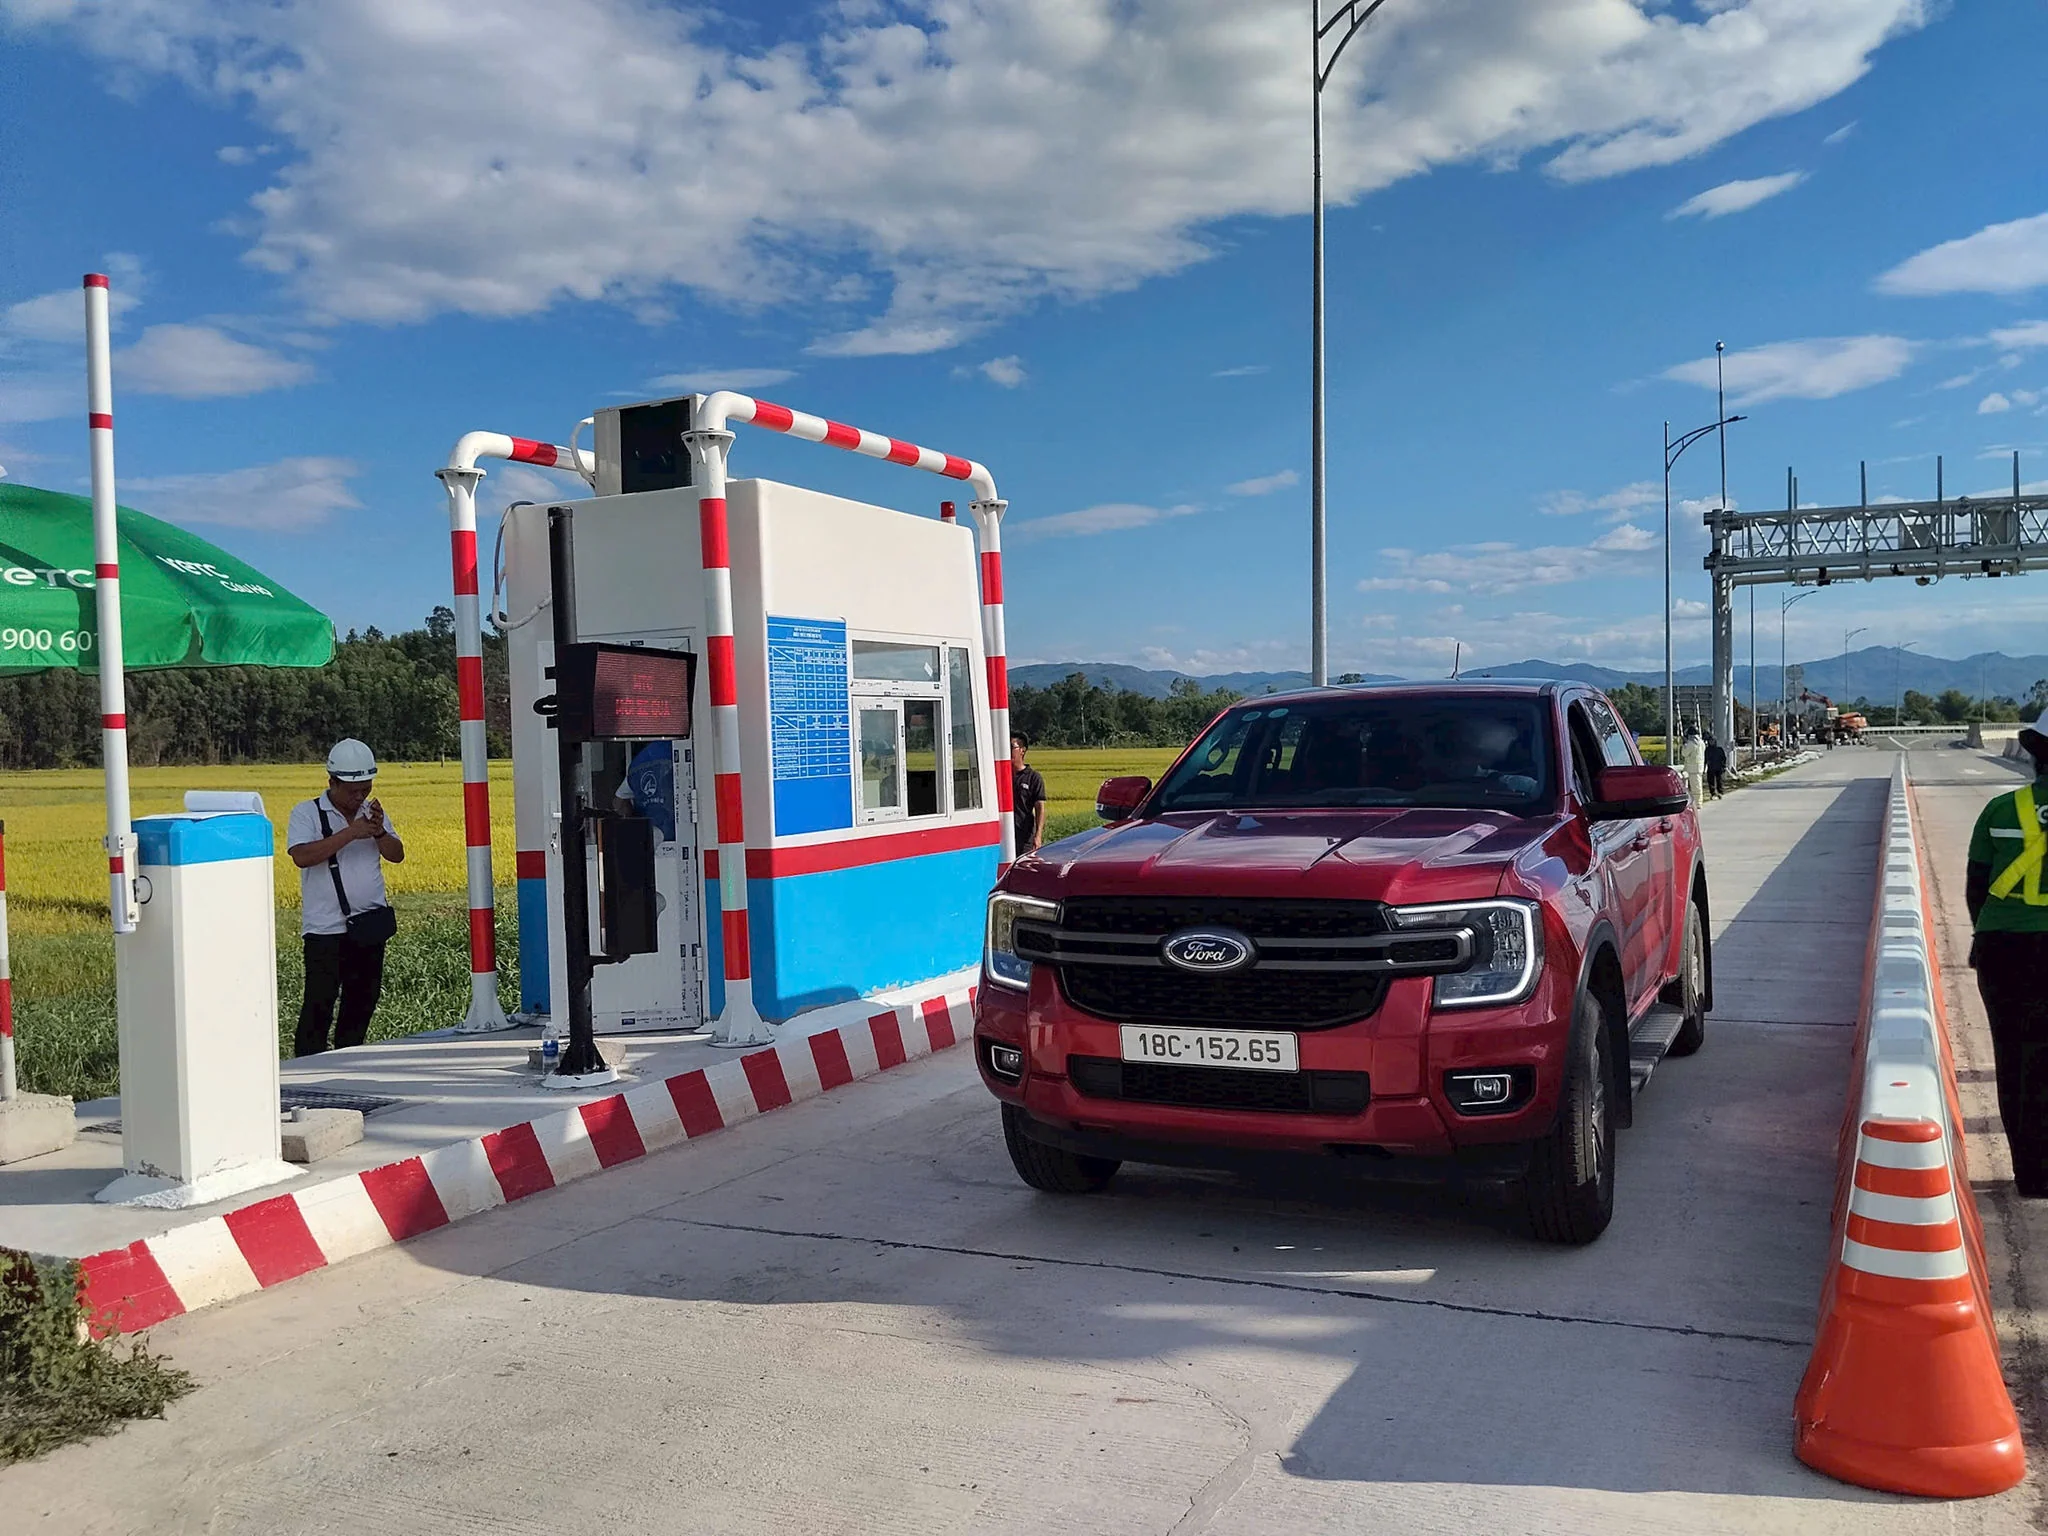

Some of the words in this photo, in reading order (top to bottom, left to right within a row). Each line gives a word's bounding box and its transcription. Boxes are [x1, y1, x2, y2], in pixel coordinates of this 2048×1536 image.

[0, 567, 96, 588] eTC
[60, 630, 98, 651] 60
[1183, 940, 1226, 961] Ford
[1138, 1032, 1281, 1063] 18C-152.65
